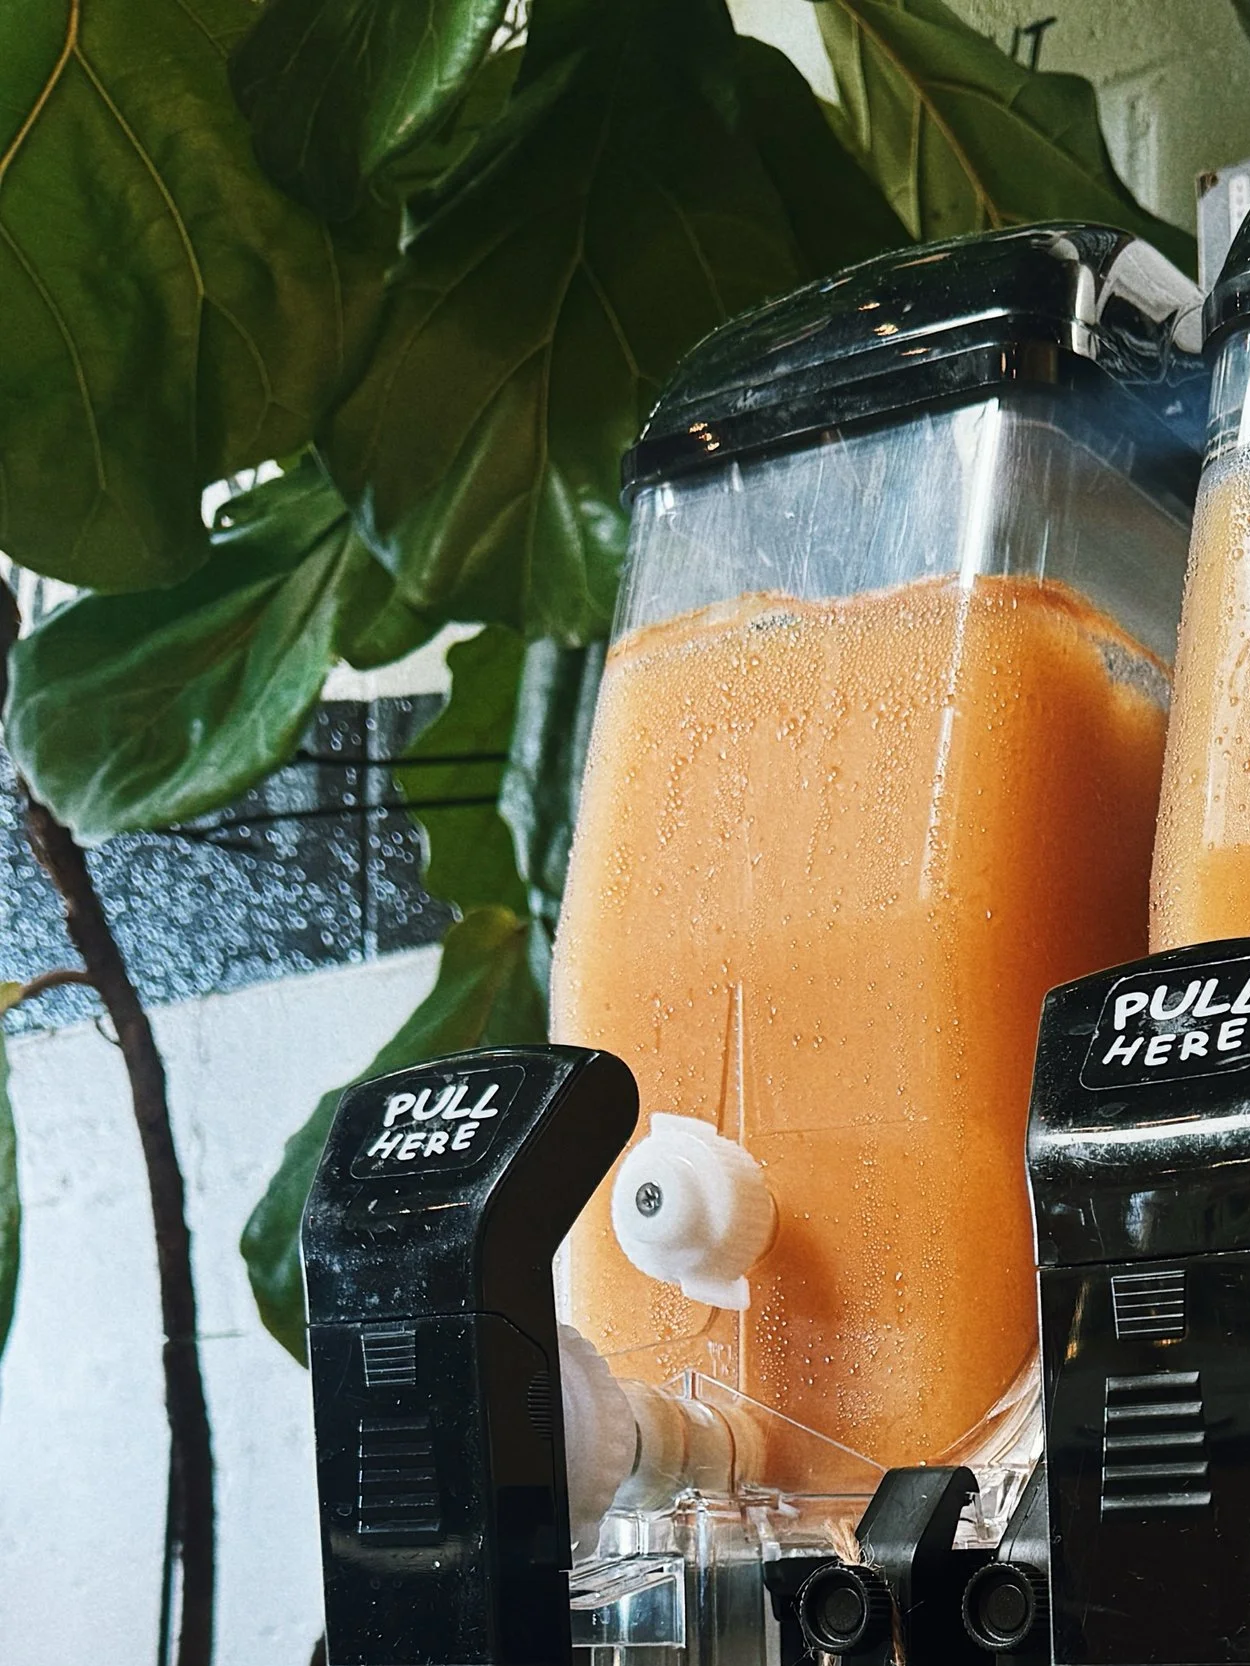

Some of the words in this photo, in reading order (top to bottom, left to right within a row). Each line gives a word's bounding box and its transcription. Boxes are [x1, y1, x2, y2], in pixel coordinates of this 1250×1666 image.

[1101, 1017, 1248, 1066] HERE
[383, 1083, 500, 1128] PULL
[367, 1121, 480, 1161] HERE
